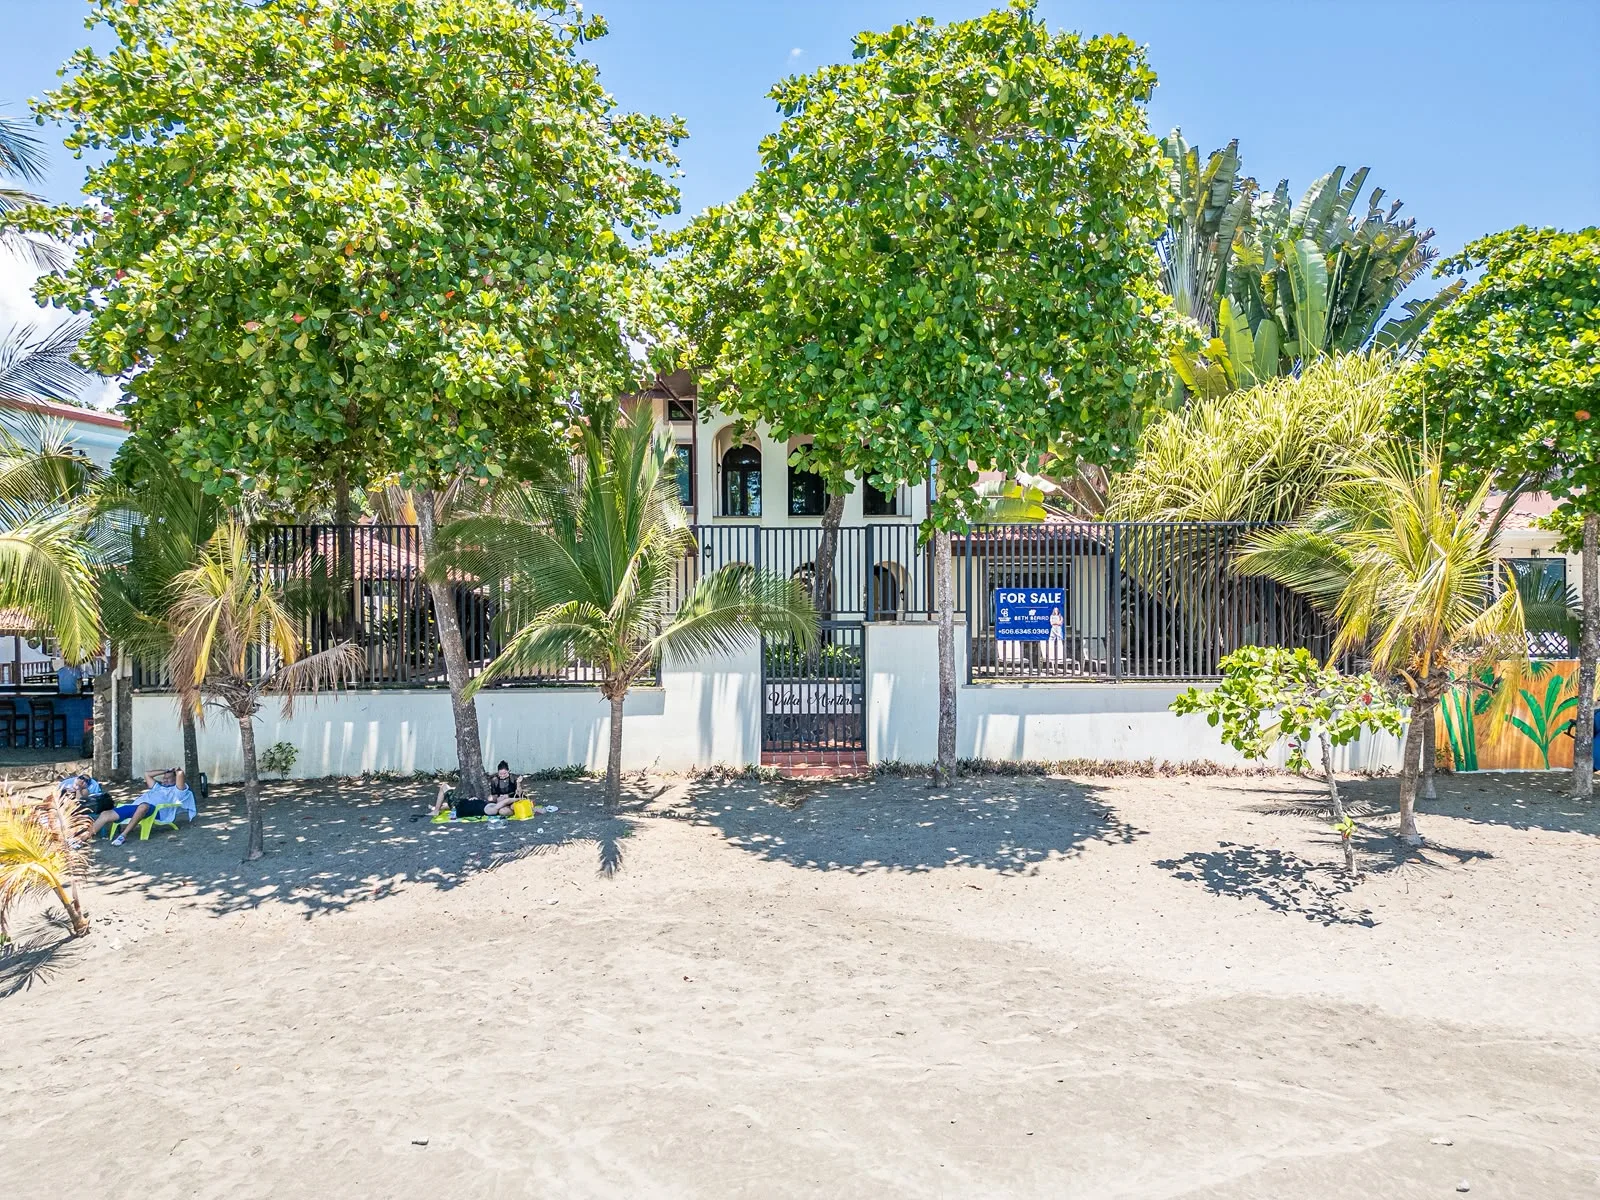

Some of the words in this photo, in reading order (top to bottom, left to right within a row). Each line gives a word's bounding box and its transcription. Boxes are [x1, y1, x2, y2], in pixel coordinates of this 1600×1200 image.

[999, 592, 1026, 604] FOR
[1030, 592, 1062, 604] SALE
[768, 690, 801, 707] Villa
